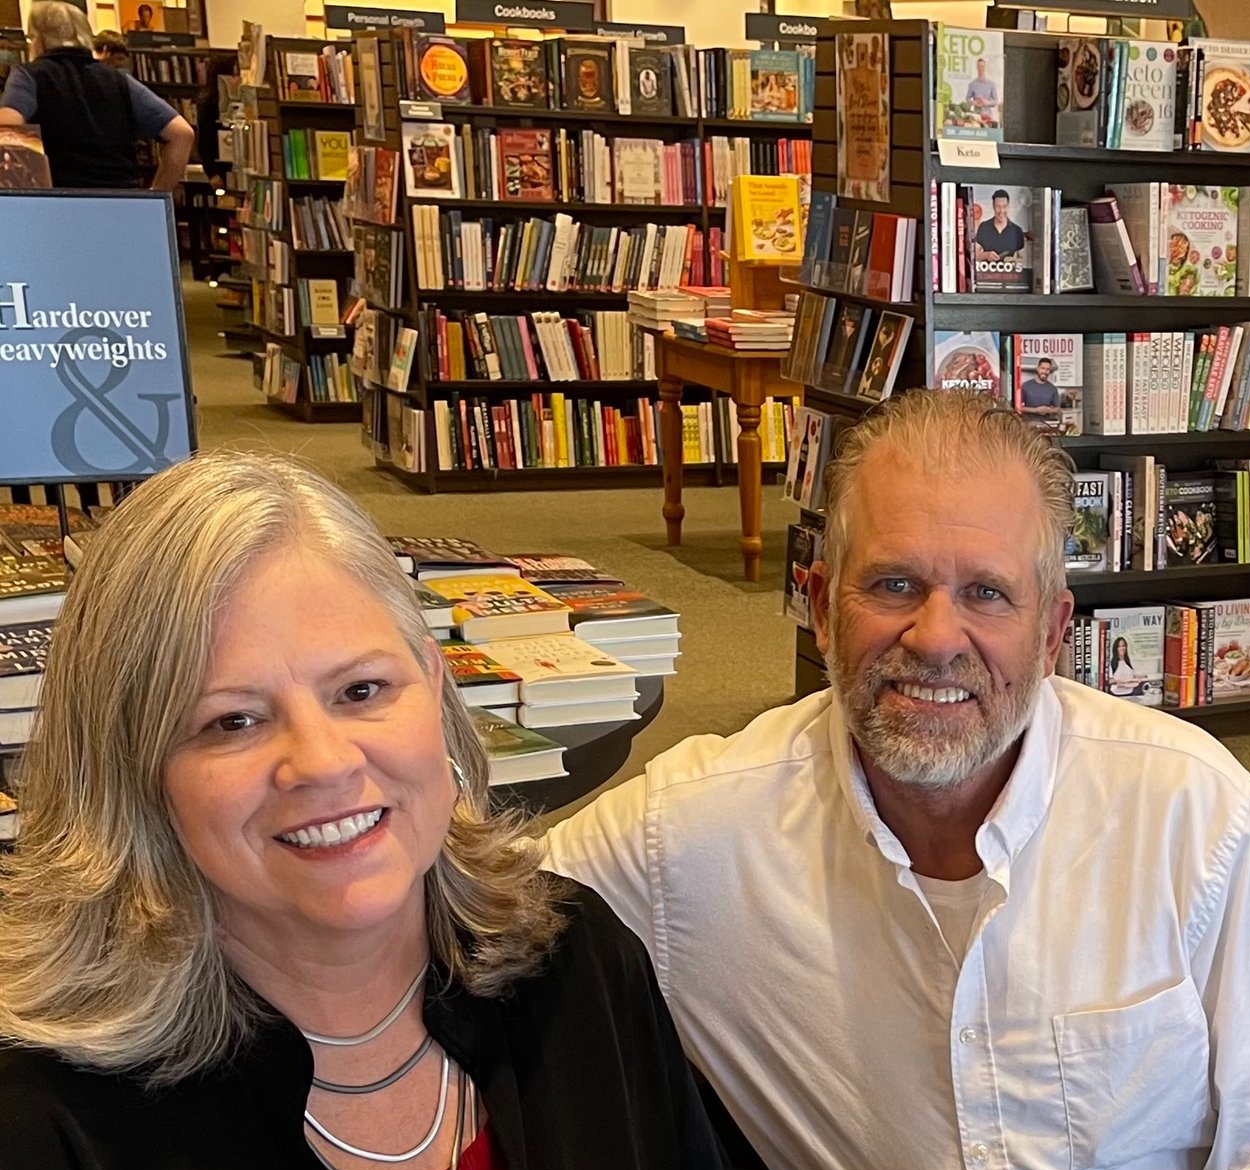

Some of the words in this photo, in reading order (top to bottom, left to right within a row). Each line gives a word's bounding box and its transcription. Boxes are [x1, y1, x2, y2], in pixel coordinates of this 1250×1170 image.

[495, 4, 556, 20] Cookbooks
[348, 12, 389, 25] Personal
[391, 15, 425, 28] Growth
[779, 21, 817, 37] Cookbo
[1159, 103, 1172, 120] 16
[320, 138, 348, 150] YOU
[957, 146, 980, 158] Keto
[1176, 211, 1229, 221] KETOGENIC
[1183, 221, 1223, 231] COOKING
[0, 282, 152, 328] Hardcover
[0, 335, 167, 368] eavyweights
[1043, 338, 1074, 353] GUIDO
[1078, 482, 1103, 496] FAST
[1179, 485, 1213, 496] COOKBOOK
[1143, 614, 1163, 626] WAY
